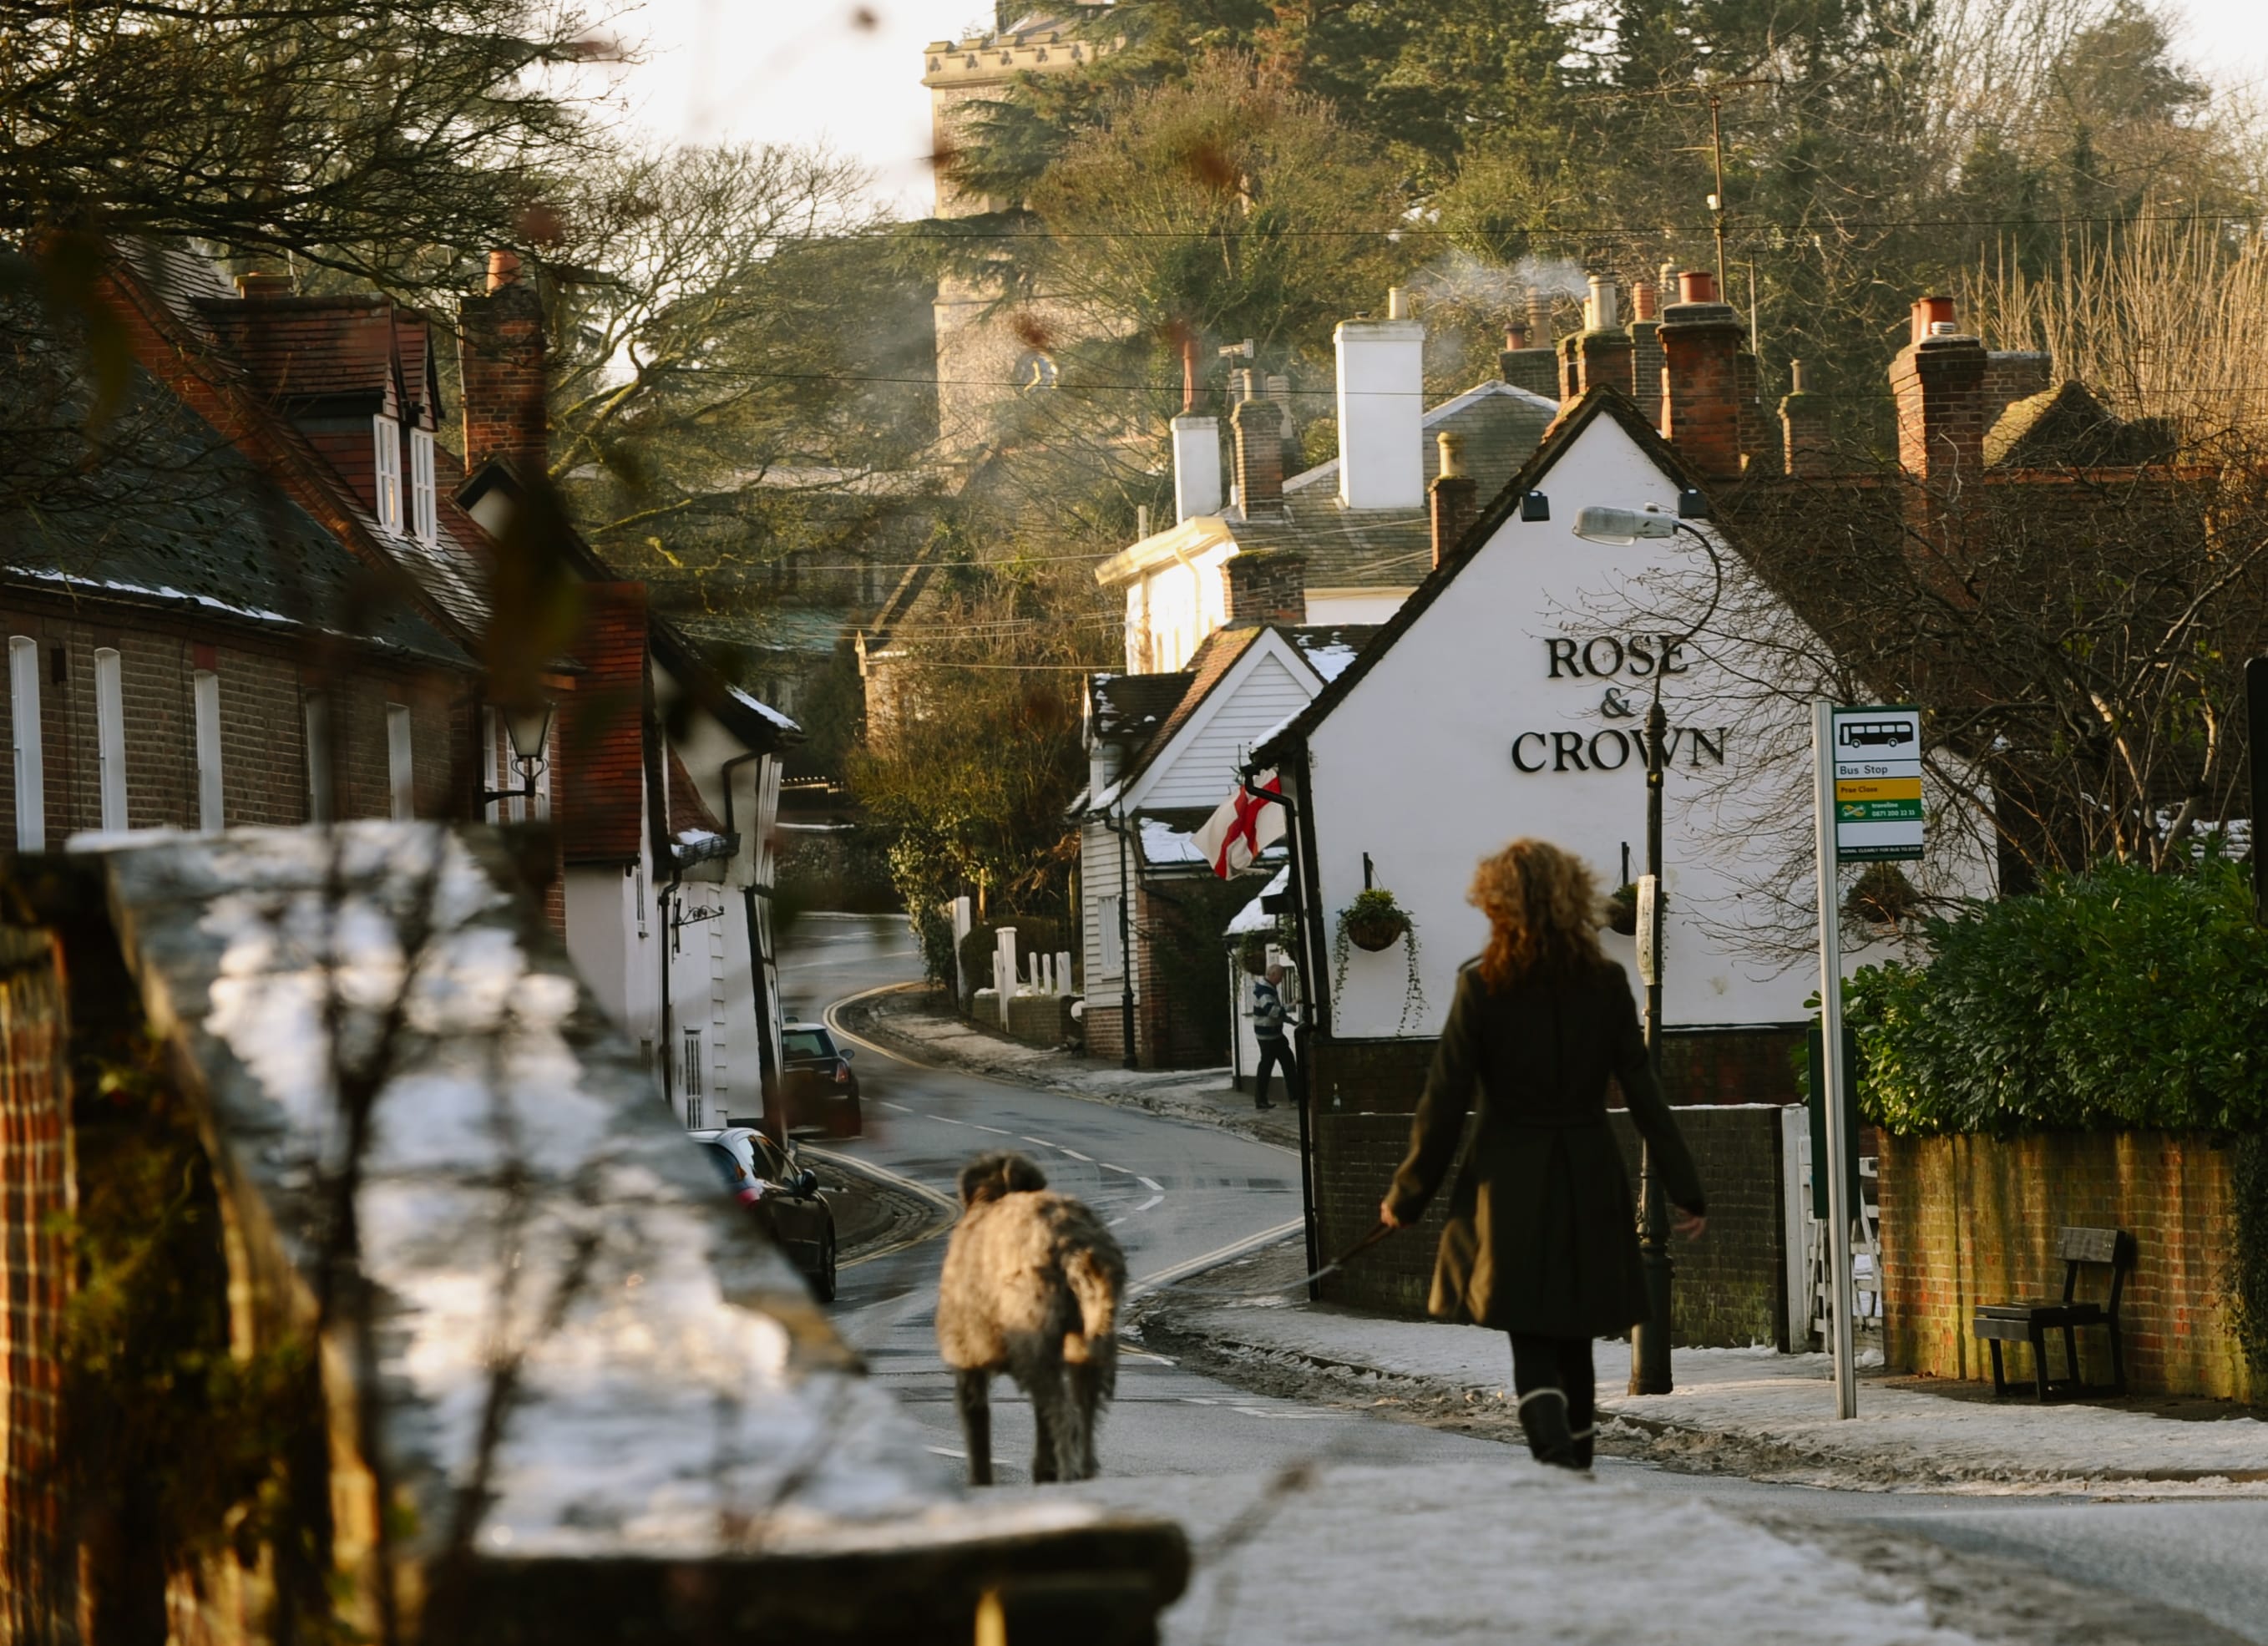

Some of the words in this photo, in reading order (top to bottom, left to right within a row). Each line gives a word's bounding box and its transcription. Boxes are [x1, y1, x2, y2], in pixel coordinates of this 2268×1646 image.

[1544, 634, 1688, 678] ROSE
[1600, 687, 1637, 719] &
[1511, 727, 1728, 772] CROWN
[1840, 766, 1859, 775] Bus
[1864, 765, 1888, 775] Stop
